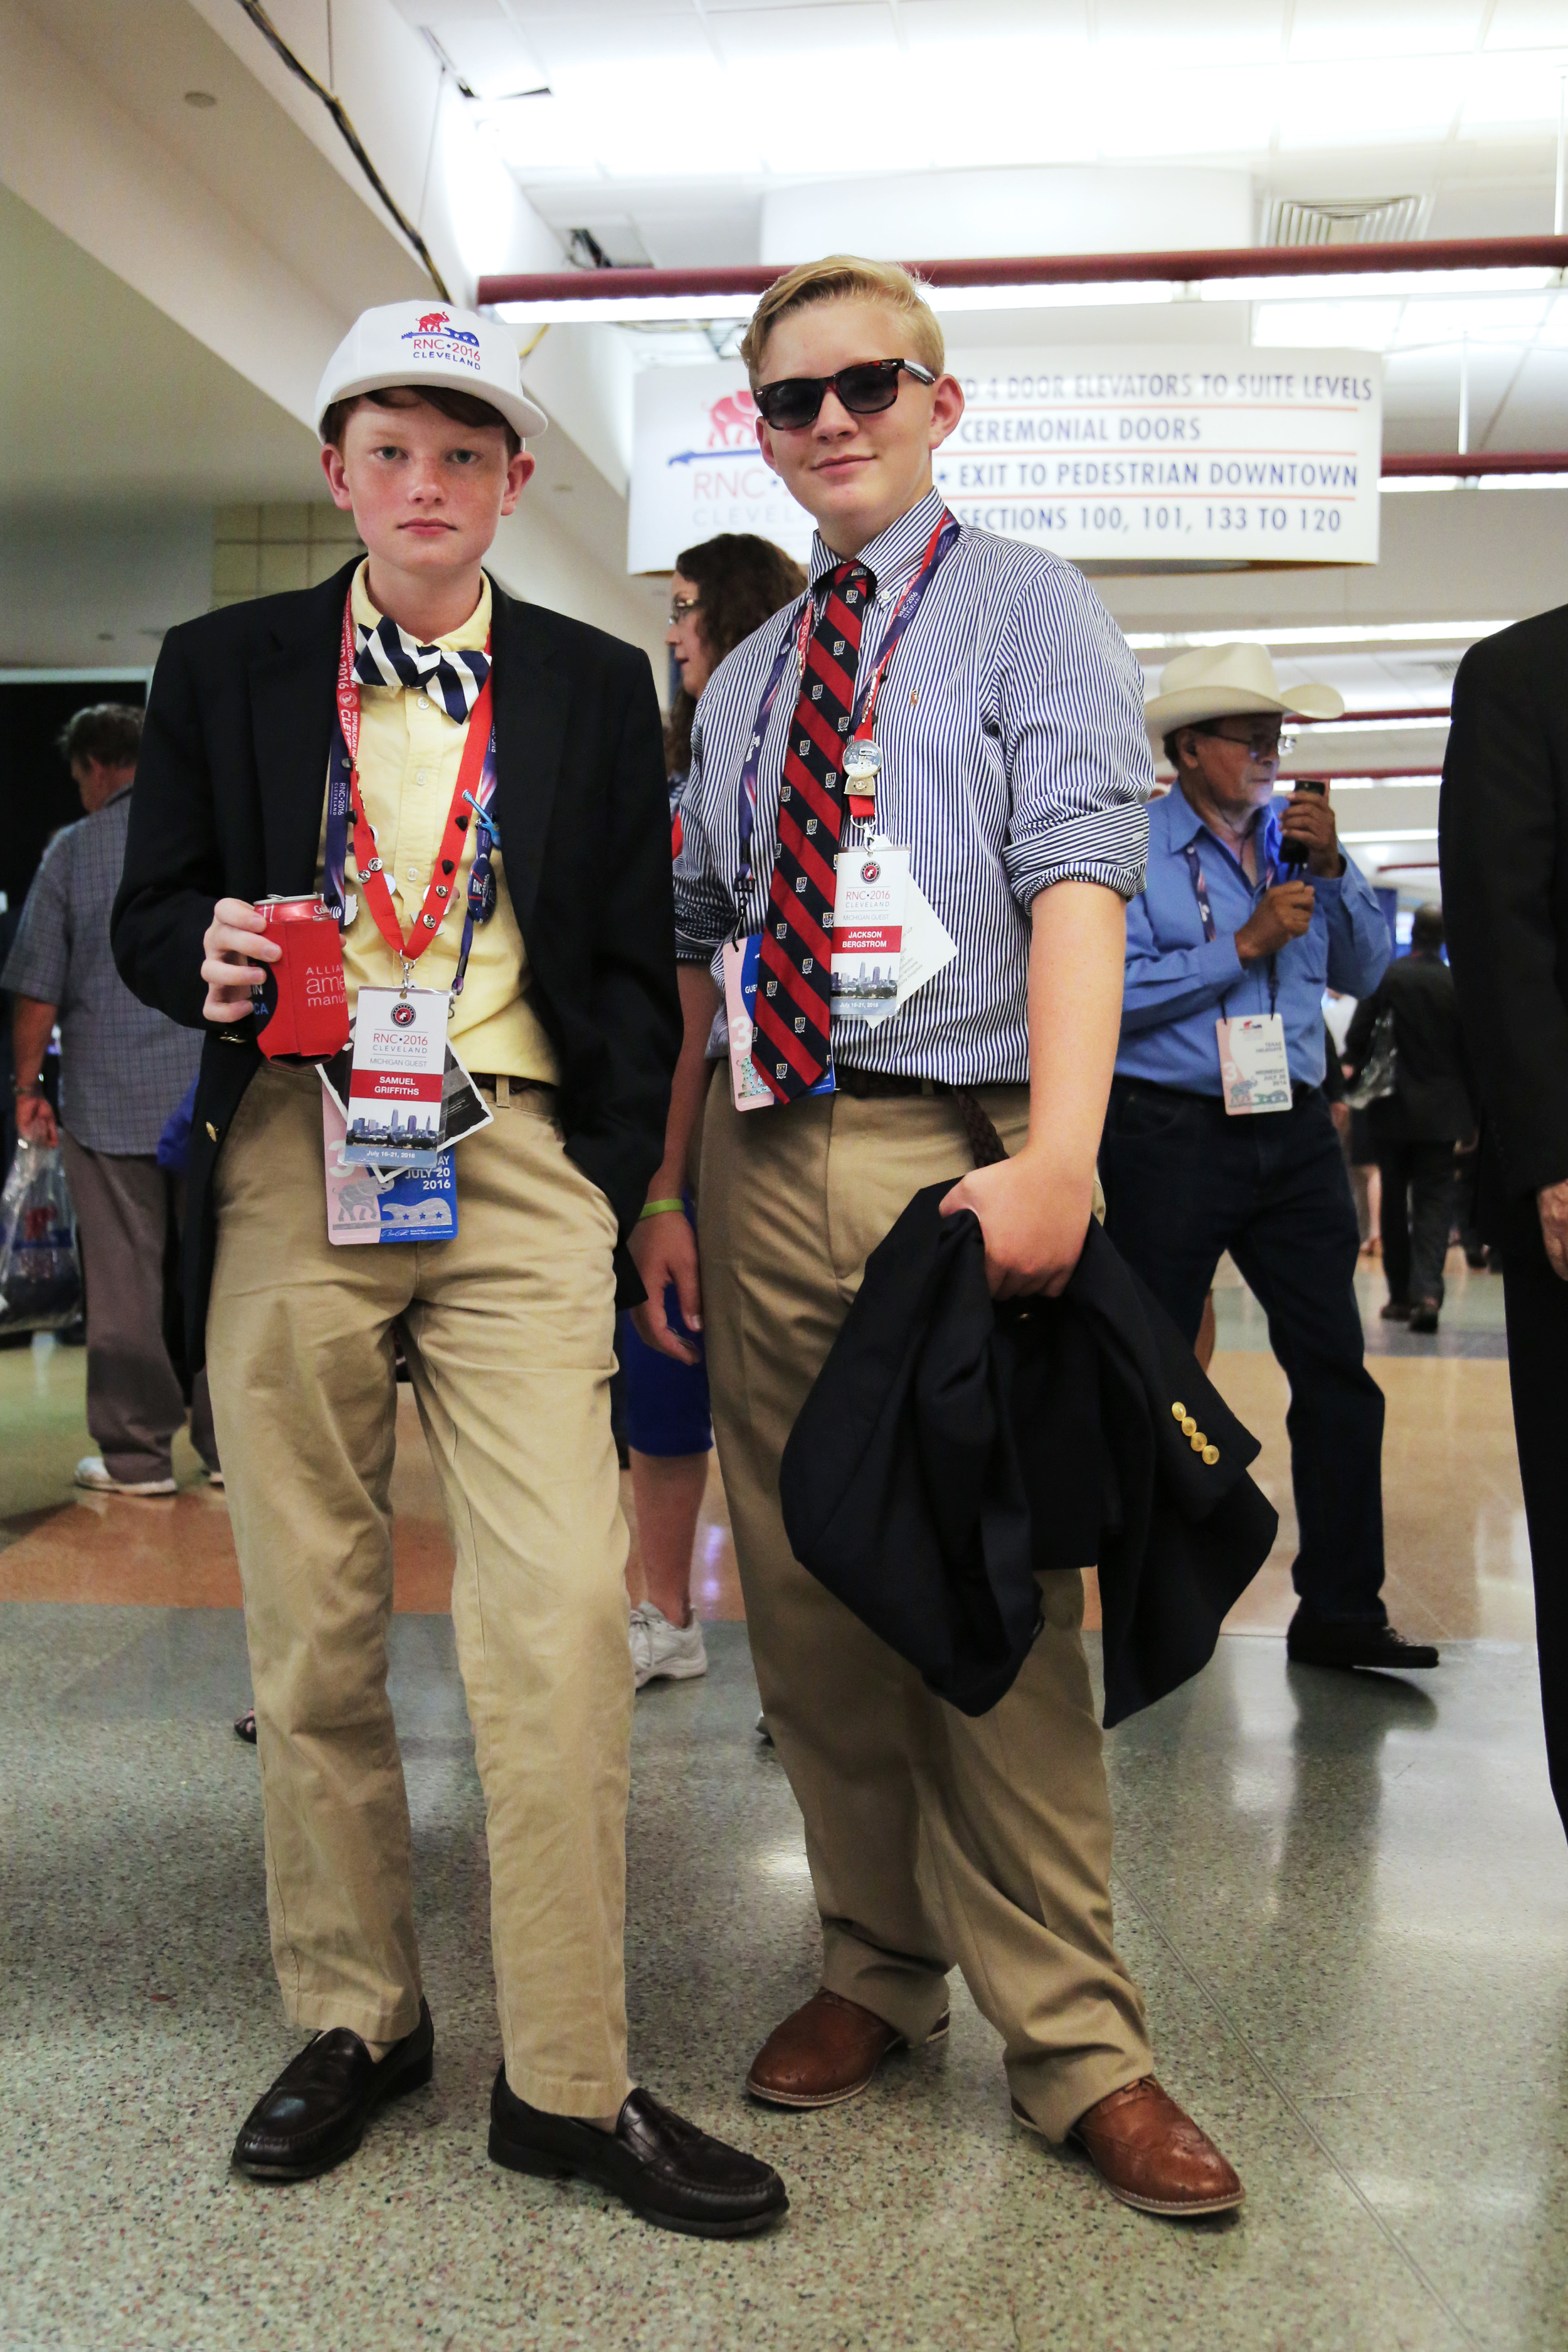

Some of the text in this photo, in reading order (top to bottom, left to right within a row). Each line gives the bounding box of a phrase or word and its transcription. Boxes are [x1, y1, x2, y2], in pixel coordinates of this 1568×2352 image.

[414, 339, 480, 362] RNC 2016
[413, 352, 480, 370] CLEVELAND
[986, 378, 999, 401] 4
[1009, 376, 1064, 399] DOOR
[1075, 374, 1191, 398] ELEVATORS
[1202, 374, 1227, 397] TO
[1237, 374, 1295, 398] SUITE
[1303, 375, 1371, 401] LEVELS
[960, 418, 1200, 443] CEREMONIAL DOORS
[960, 462, 1357, 487] EXIT TO PEDESTRIAN DOWNTOWN
[694, 469, 765, 500] RNC
[959, 507, 1340, 534] SECTIONS 100, 101, 133 TO 120
[903, 595, 921, 619] CLEVELAND
[908, 591, 918, 605] 2016
[338, 661, 349, 689] 2016
[472, 878, 482, 895] RNC
[846, 890, 890, 900] RNC 2016
[848, 931, 882, 939] JACKSON
[373, 1033, 428, 1046] RNC 2016
[730, 1015, 751, 1051] 3
[373, 1044, 428, 1054] CLEVELAND
[1222, 1061, 1237, 1082] 3
[379, 1076, 415, 1086] SAMUEL
[374, 1086, 420, 1096] GRIFFITHS
[405, 1168, 450, 1179] JULY 20
[423, 1180, 451, 1190] 2016
